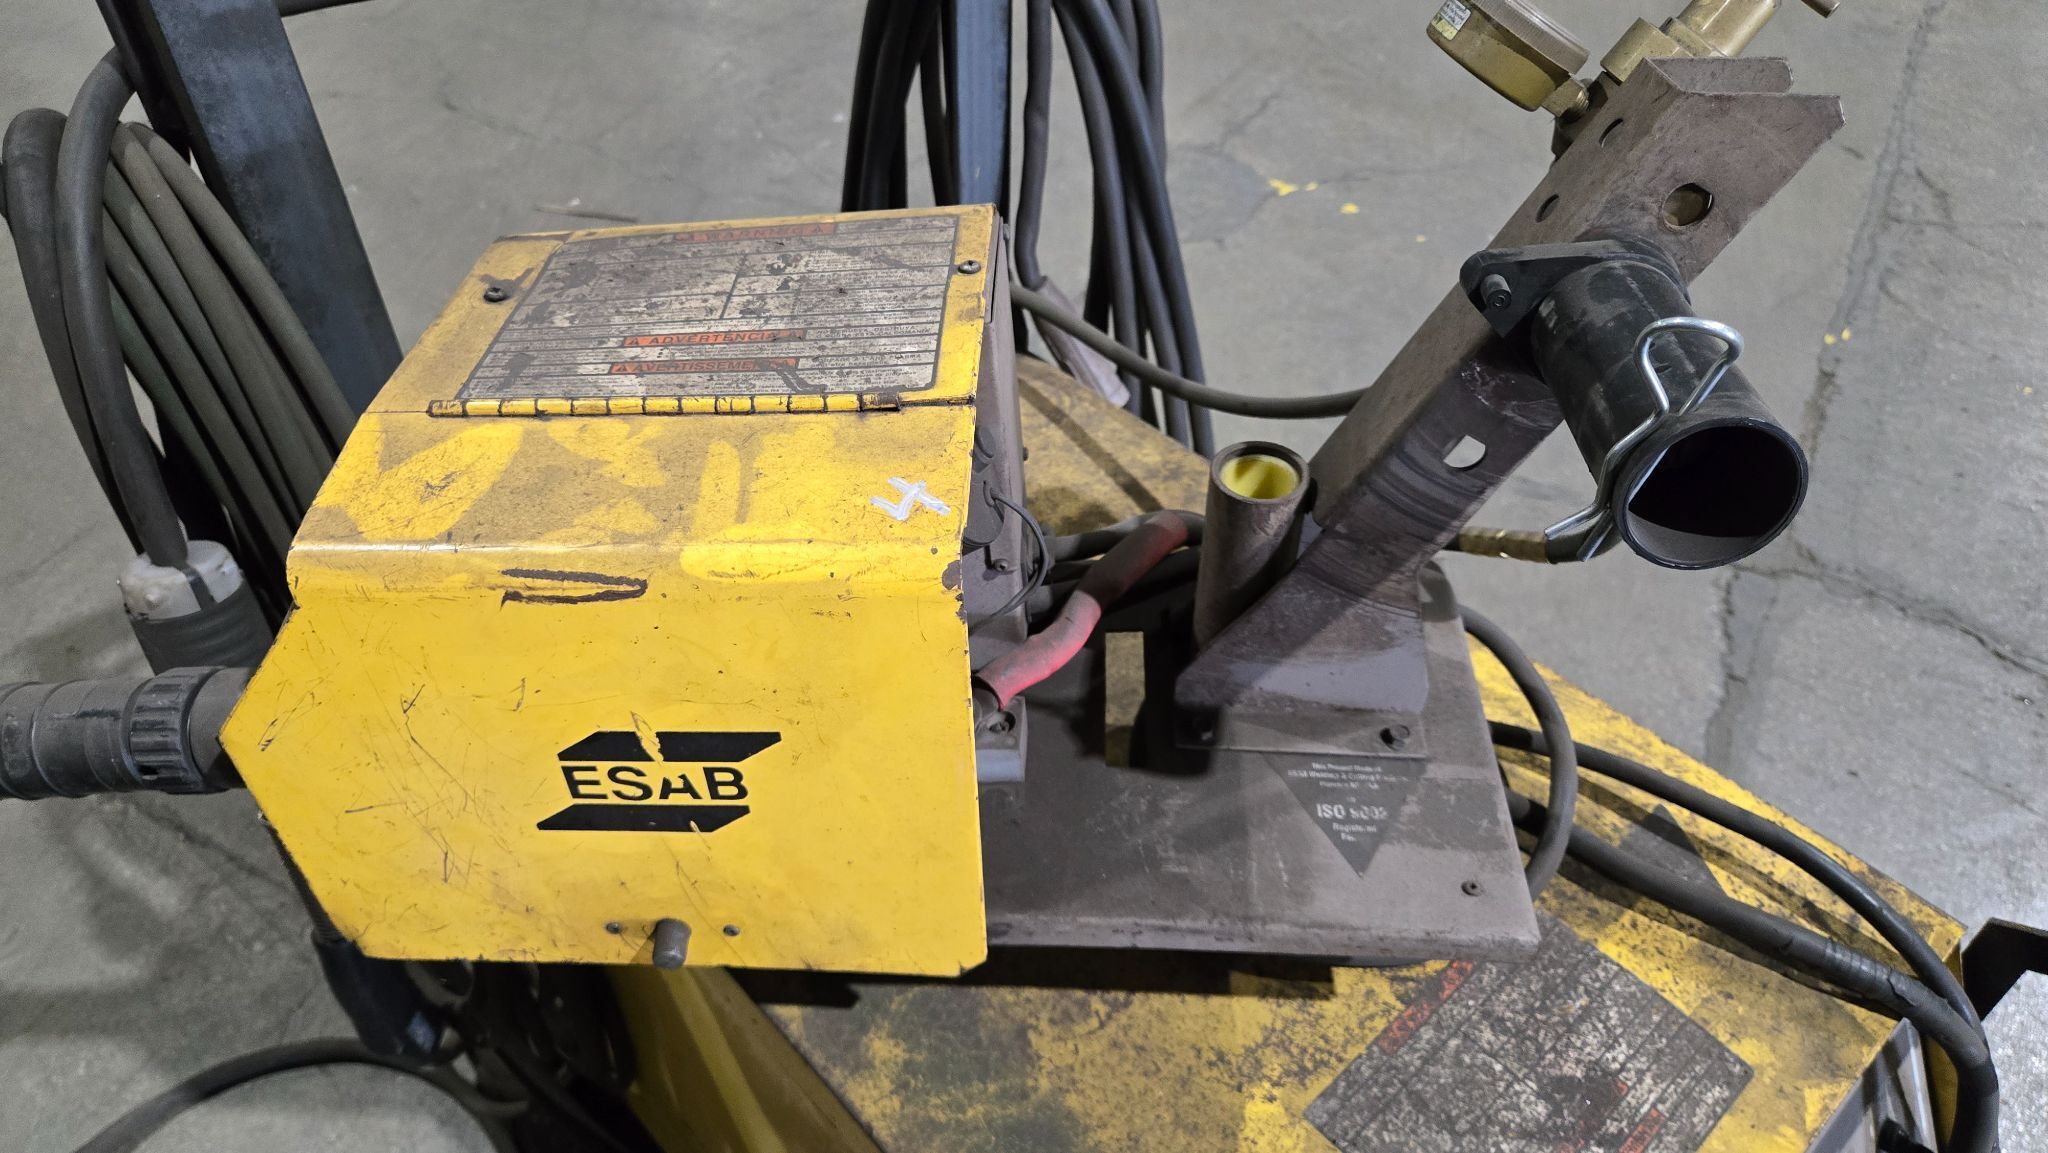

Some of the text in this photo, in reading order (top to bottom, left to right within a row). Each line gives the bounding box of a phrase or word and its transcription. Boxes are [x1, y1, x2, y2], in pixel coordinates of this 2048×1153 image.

[870, 477, 951, 521] 4
[561, 766, 749, 801] ESAB
[1316, 803, 1346, 819] ISO
